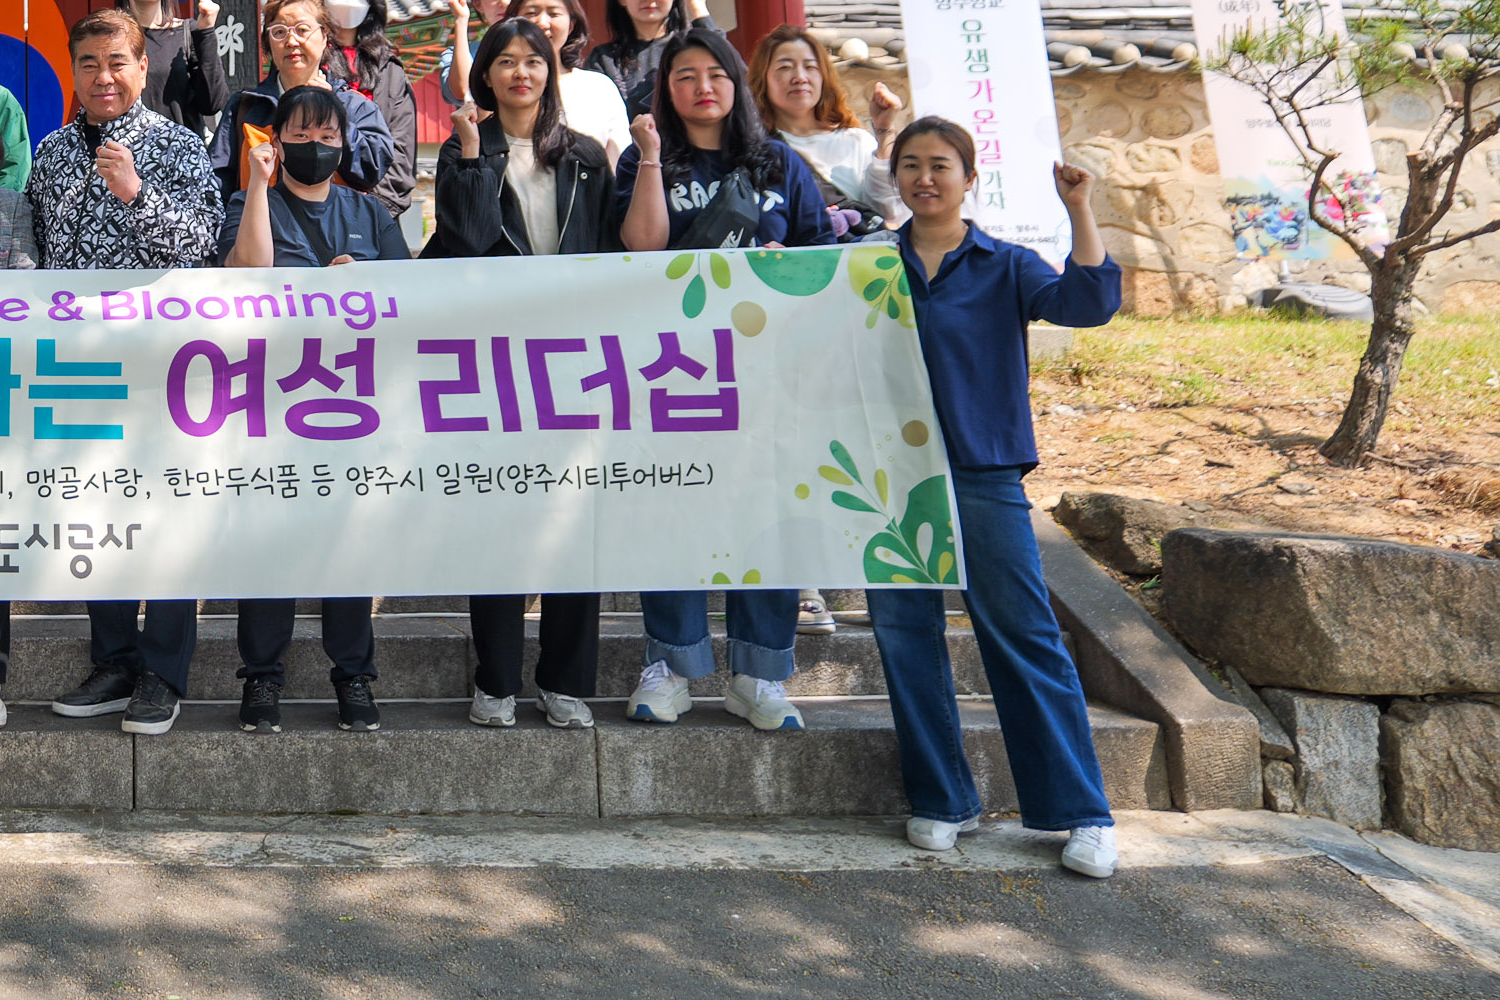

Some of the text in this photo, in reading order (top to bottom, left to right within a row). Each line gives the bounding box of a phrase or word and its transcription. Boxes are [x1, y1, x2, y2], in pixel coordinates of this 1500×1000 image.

[960, 19, 1005, 210] 유생 가온길 가자
[48, 290, 85, 321] &
[166, 337, 381, 441] 여성
[417, 328, 740, 433] 리더십
[26, 466, 151, 500] 맹골사랑,
[163, 464, 301, 499] 한만두식품
[311, 464, 335, 497] 등
[346, 466, 424, 496] 양주시
[436, 462, 714, 496] 일원(양주시티투어버스)
